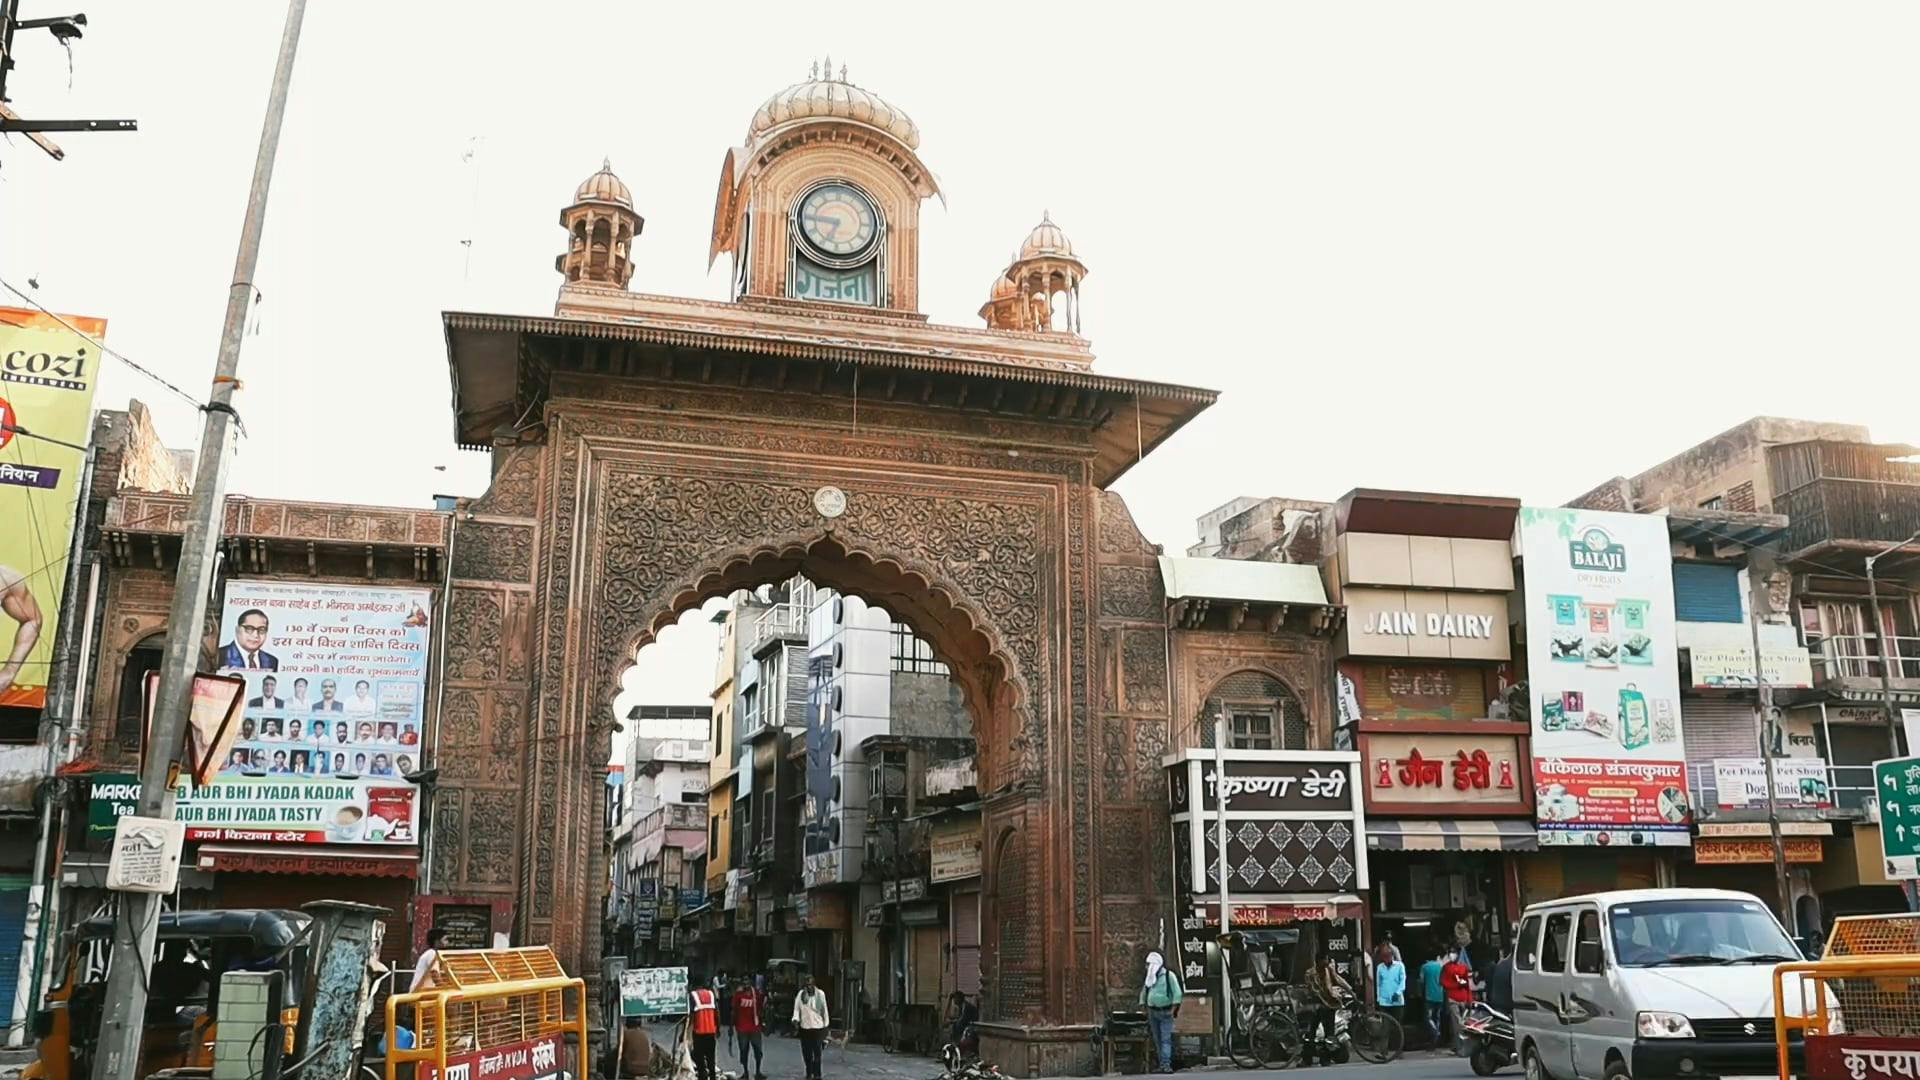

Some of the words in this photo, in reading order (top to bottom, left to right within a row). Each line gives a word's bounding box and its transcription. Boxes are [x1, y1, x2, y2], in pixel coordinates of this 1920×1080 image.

[5, 347, 87, 378] cozi
[0, 463, 39, 482] नियान
[1574, 550, 1623, 570] BALAJI
[229, 598, 250, 606] भारत
[354, 625, 386, 637] दिवस
[1364, 611, 1417, 635] JAIN
[1426, 612, 1494, 639] DAIRY
[388, 638, 420, 651] दिवस
[1396, 747, 1443, 788] जैन
[1451, 749, 1491, 791] डेरी
[1720, 767, 1736, 776] Pet
[1777, 768, 1794, 776] Pet
[1797, 768, 1823, 777] Shop
[1301, 769, 1347, 798] डेरी
[1745, 783, 1767, 797] Dog
[1776, 783, 1798, 794] linic
[176, 785, 187, 799] B
[190, 785, 219, 800] AUR
[226, 786, 251, 800] BHI
[256, 786, 300, 800] JYADA
[304, 786, 355, 801] KADAK
[112, 802, 135, 816] Tea
[175, 807, 203, 821] AUR
[207, 807, 231, 821] BHI
[235, 807, 276, 821] JYADA
[281, 807, 322, 822] TASTY
[224, 829, 272, 841] किराना
[1841, 1048, 1920, 1080] कृपया
